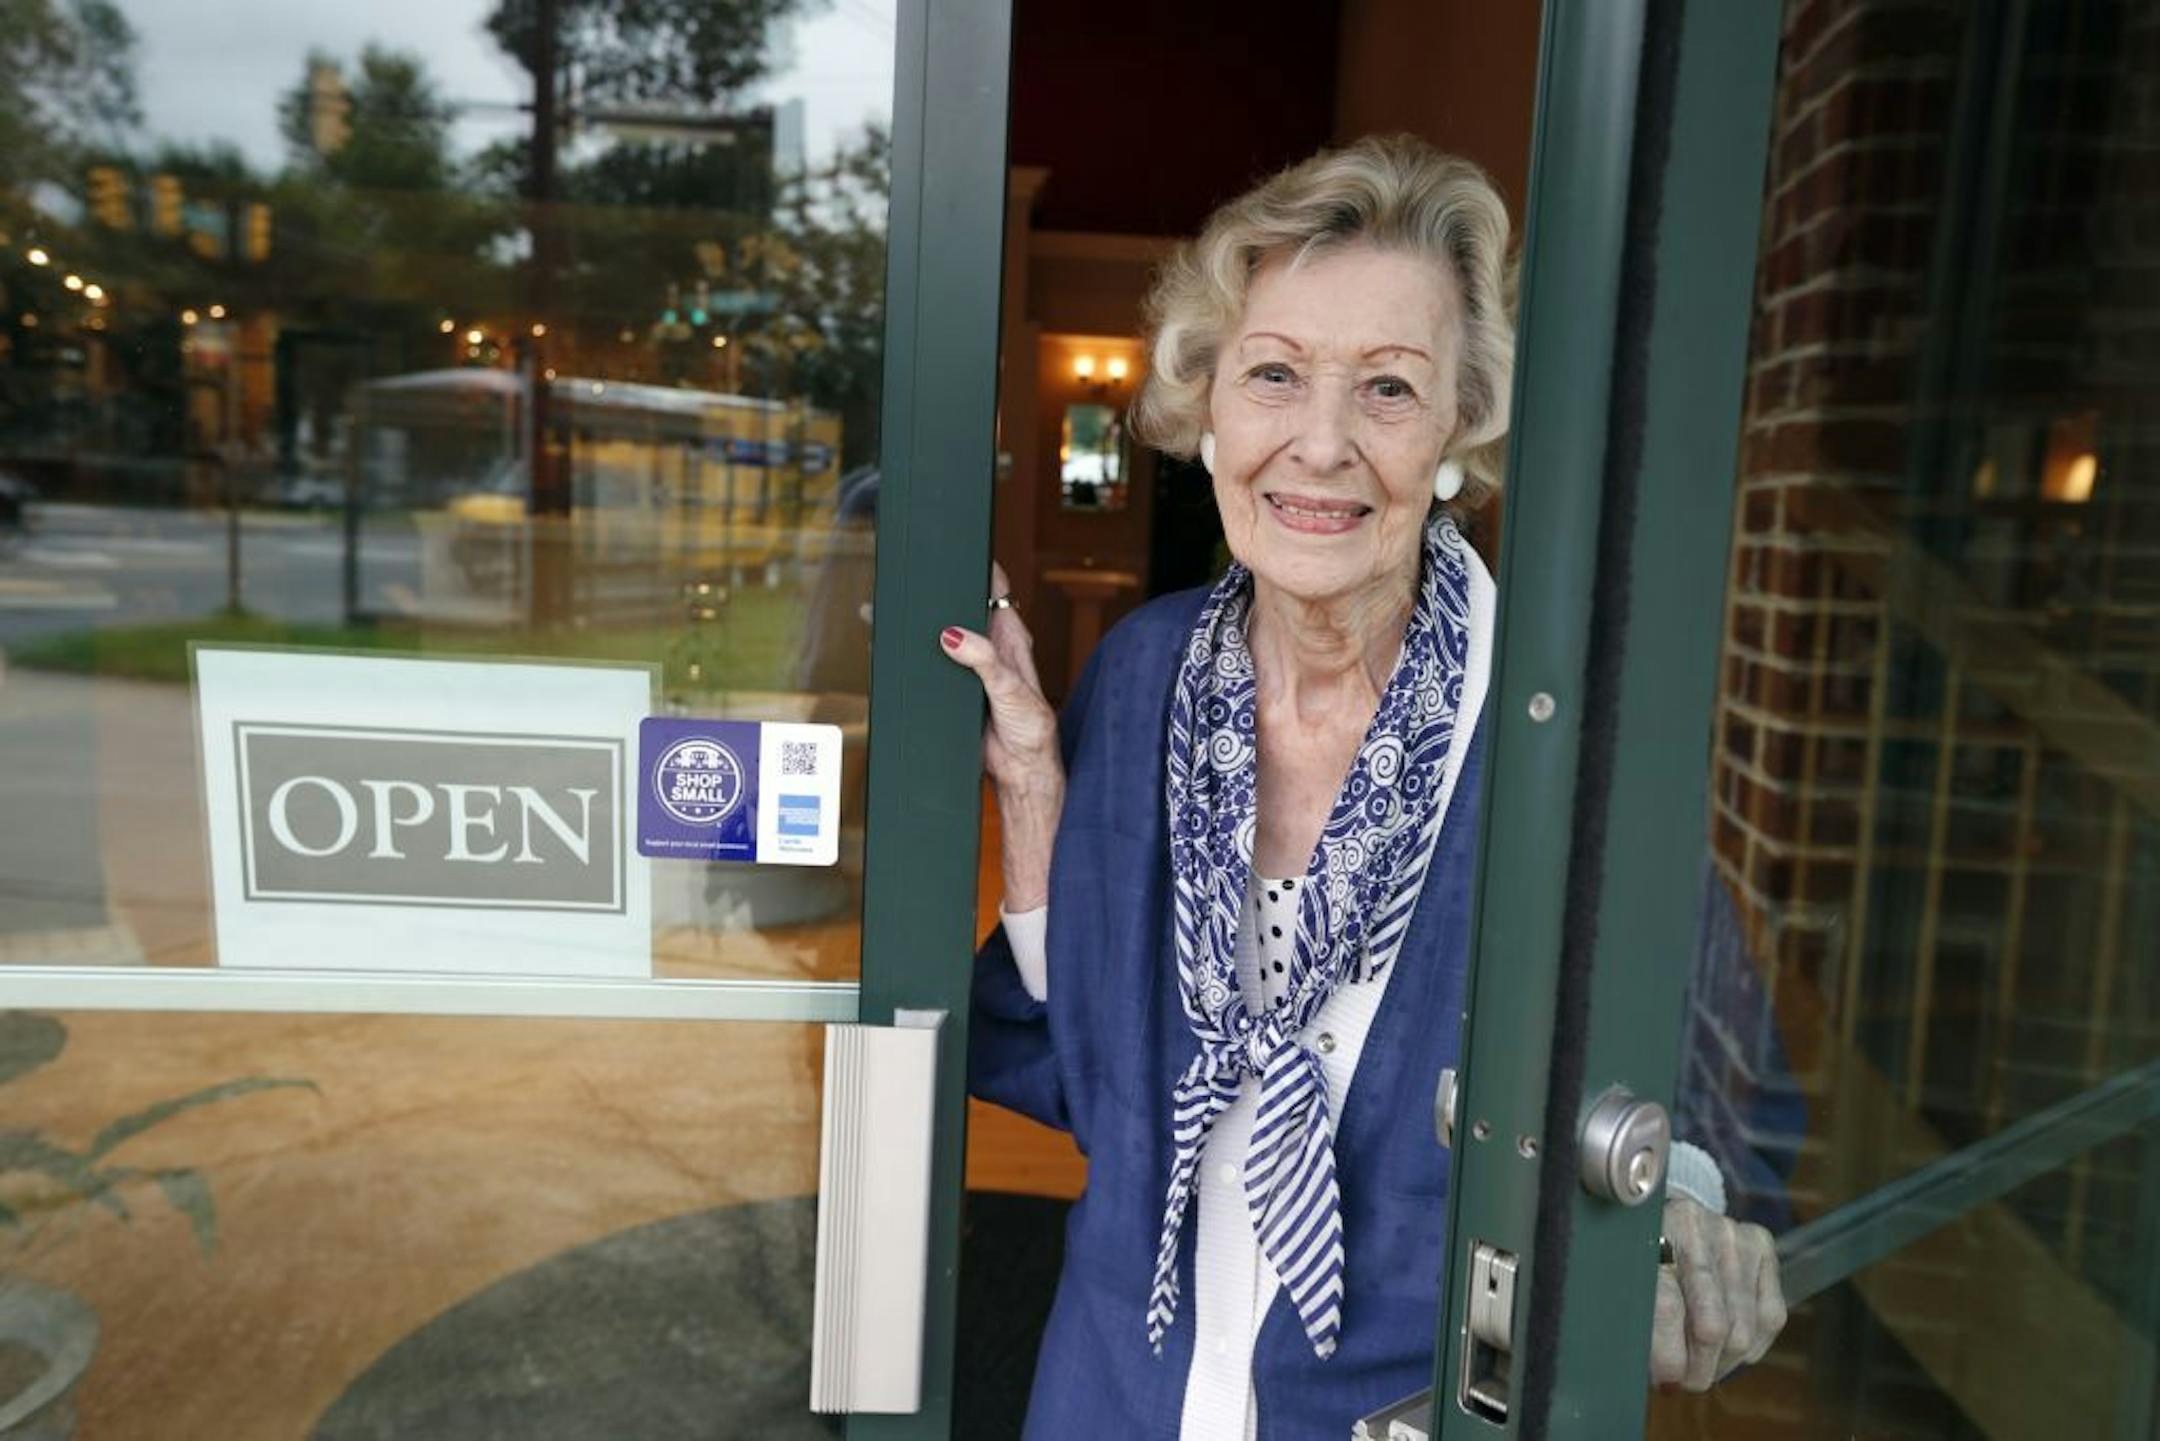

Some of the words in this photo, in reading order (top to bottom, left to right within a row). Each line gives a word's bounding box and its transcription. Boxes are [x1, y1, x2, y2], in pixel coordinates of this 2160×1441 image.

[676, 773, 723, 788] SHOP
[670, 786, 726, 803] SMALL
[268, 775, 599, 866] OPEN
